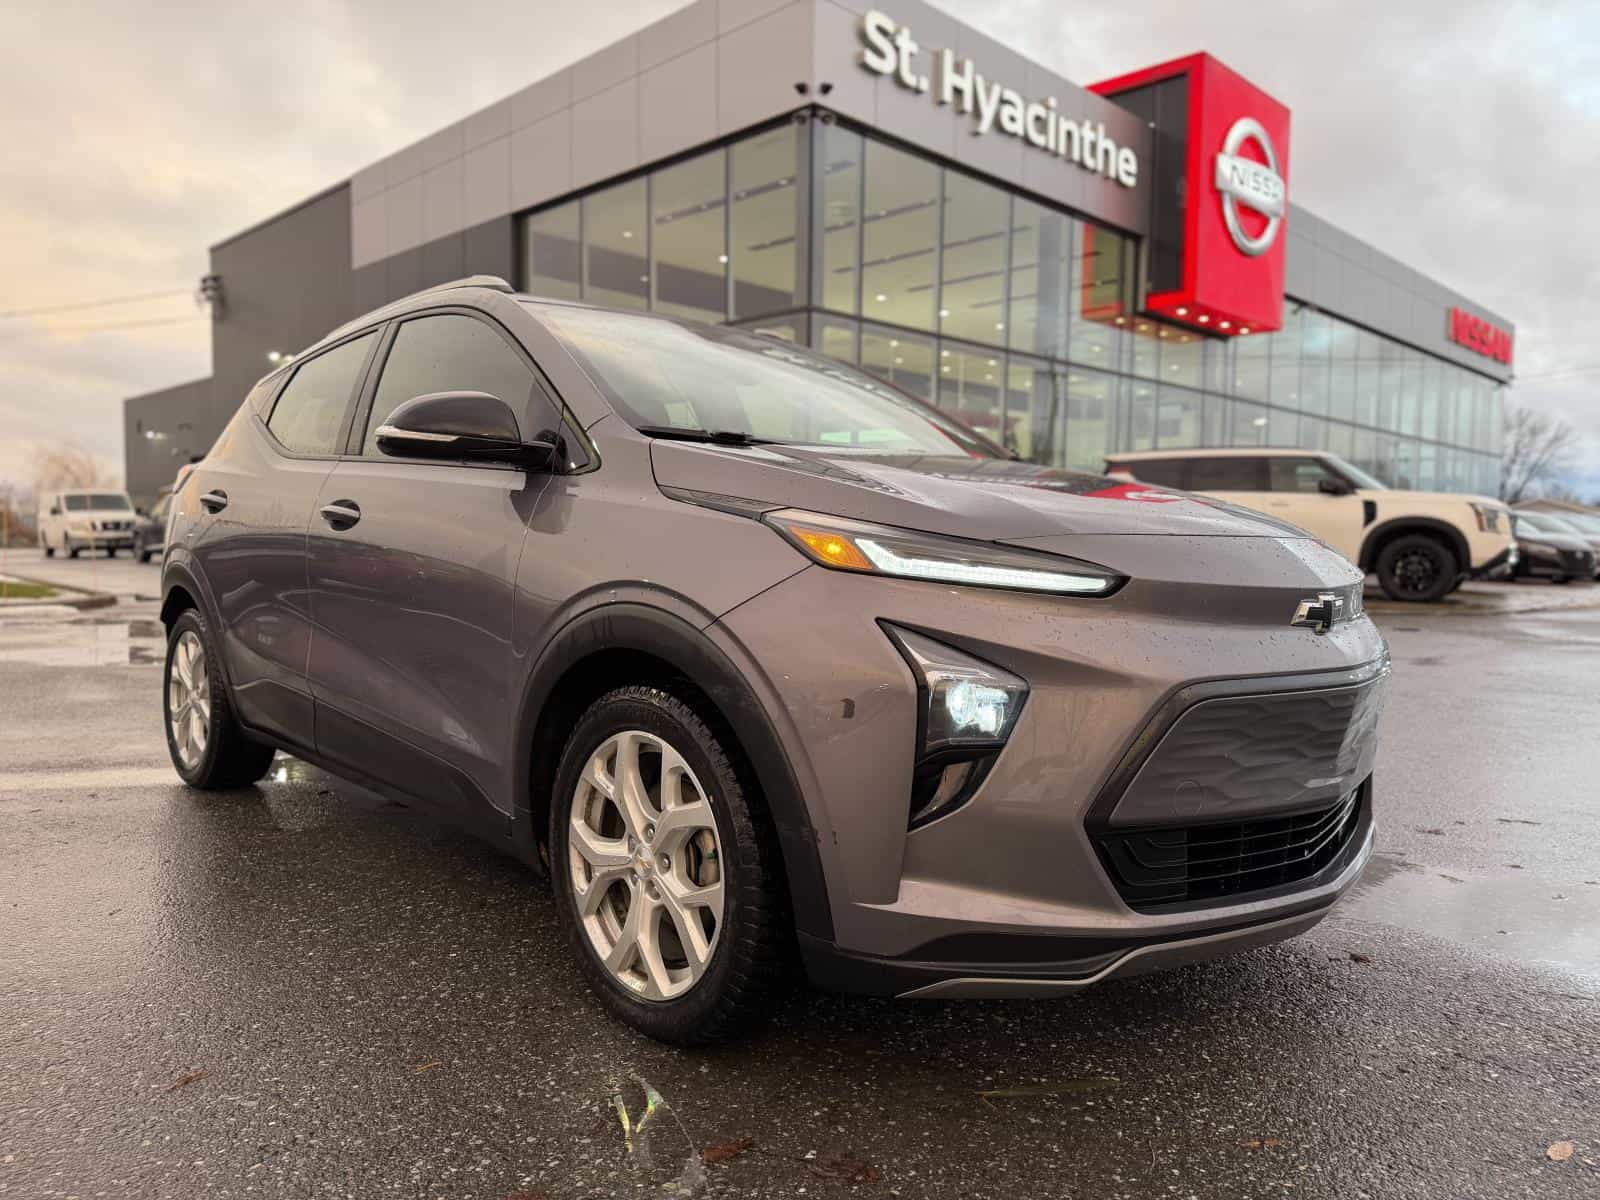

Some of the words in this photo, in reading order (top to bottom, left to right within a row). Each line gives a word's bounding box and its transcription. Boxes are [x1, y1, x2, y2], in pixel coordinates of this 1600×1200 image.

[863, 10, 929, 92] St.
[942, 49, 1138, 188] Hyacinthe
[1229, 163, 1281, 199] NISS
[1450, 306, 1512, 367] NISSAN
